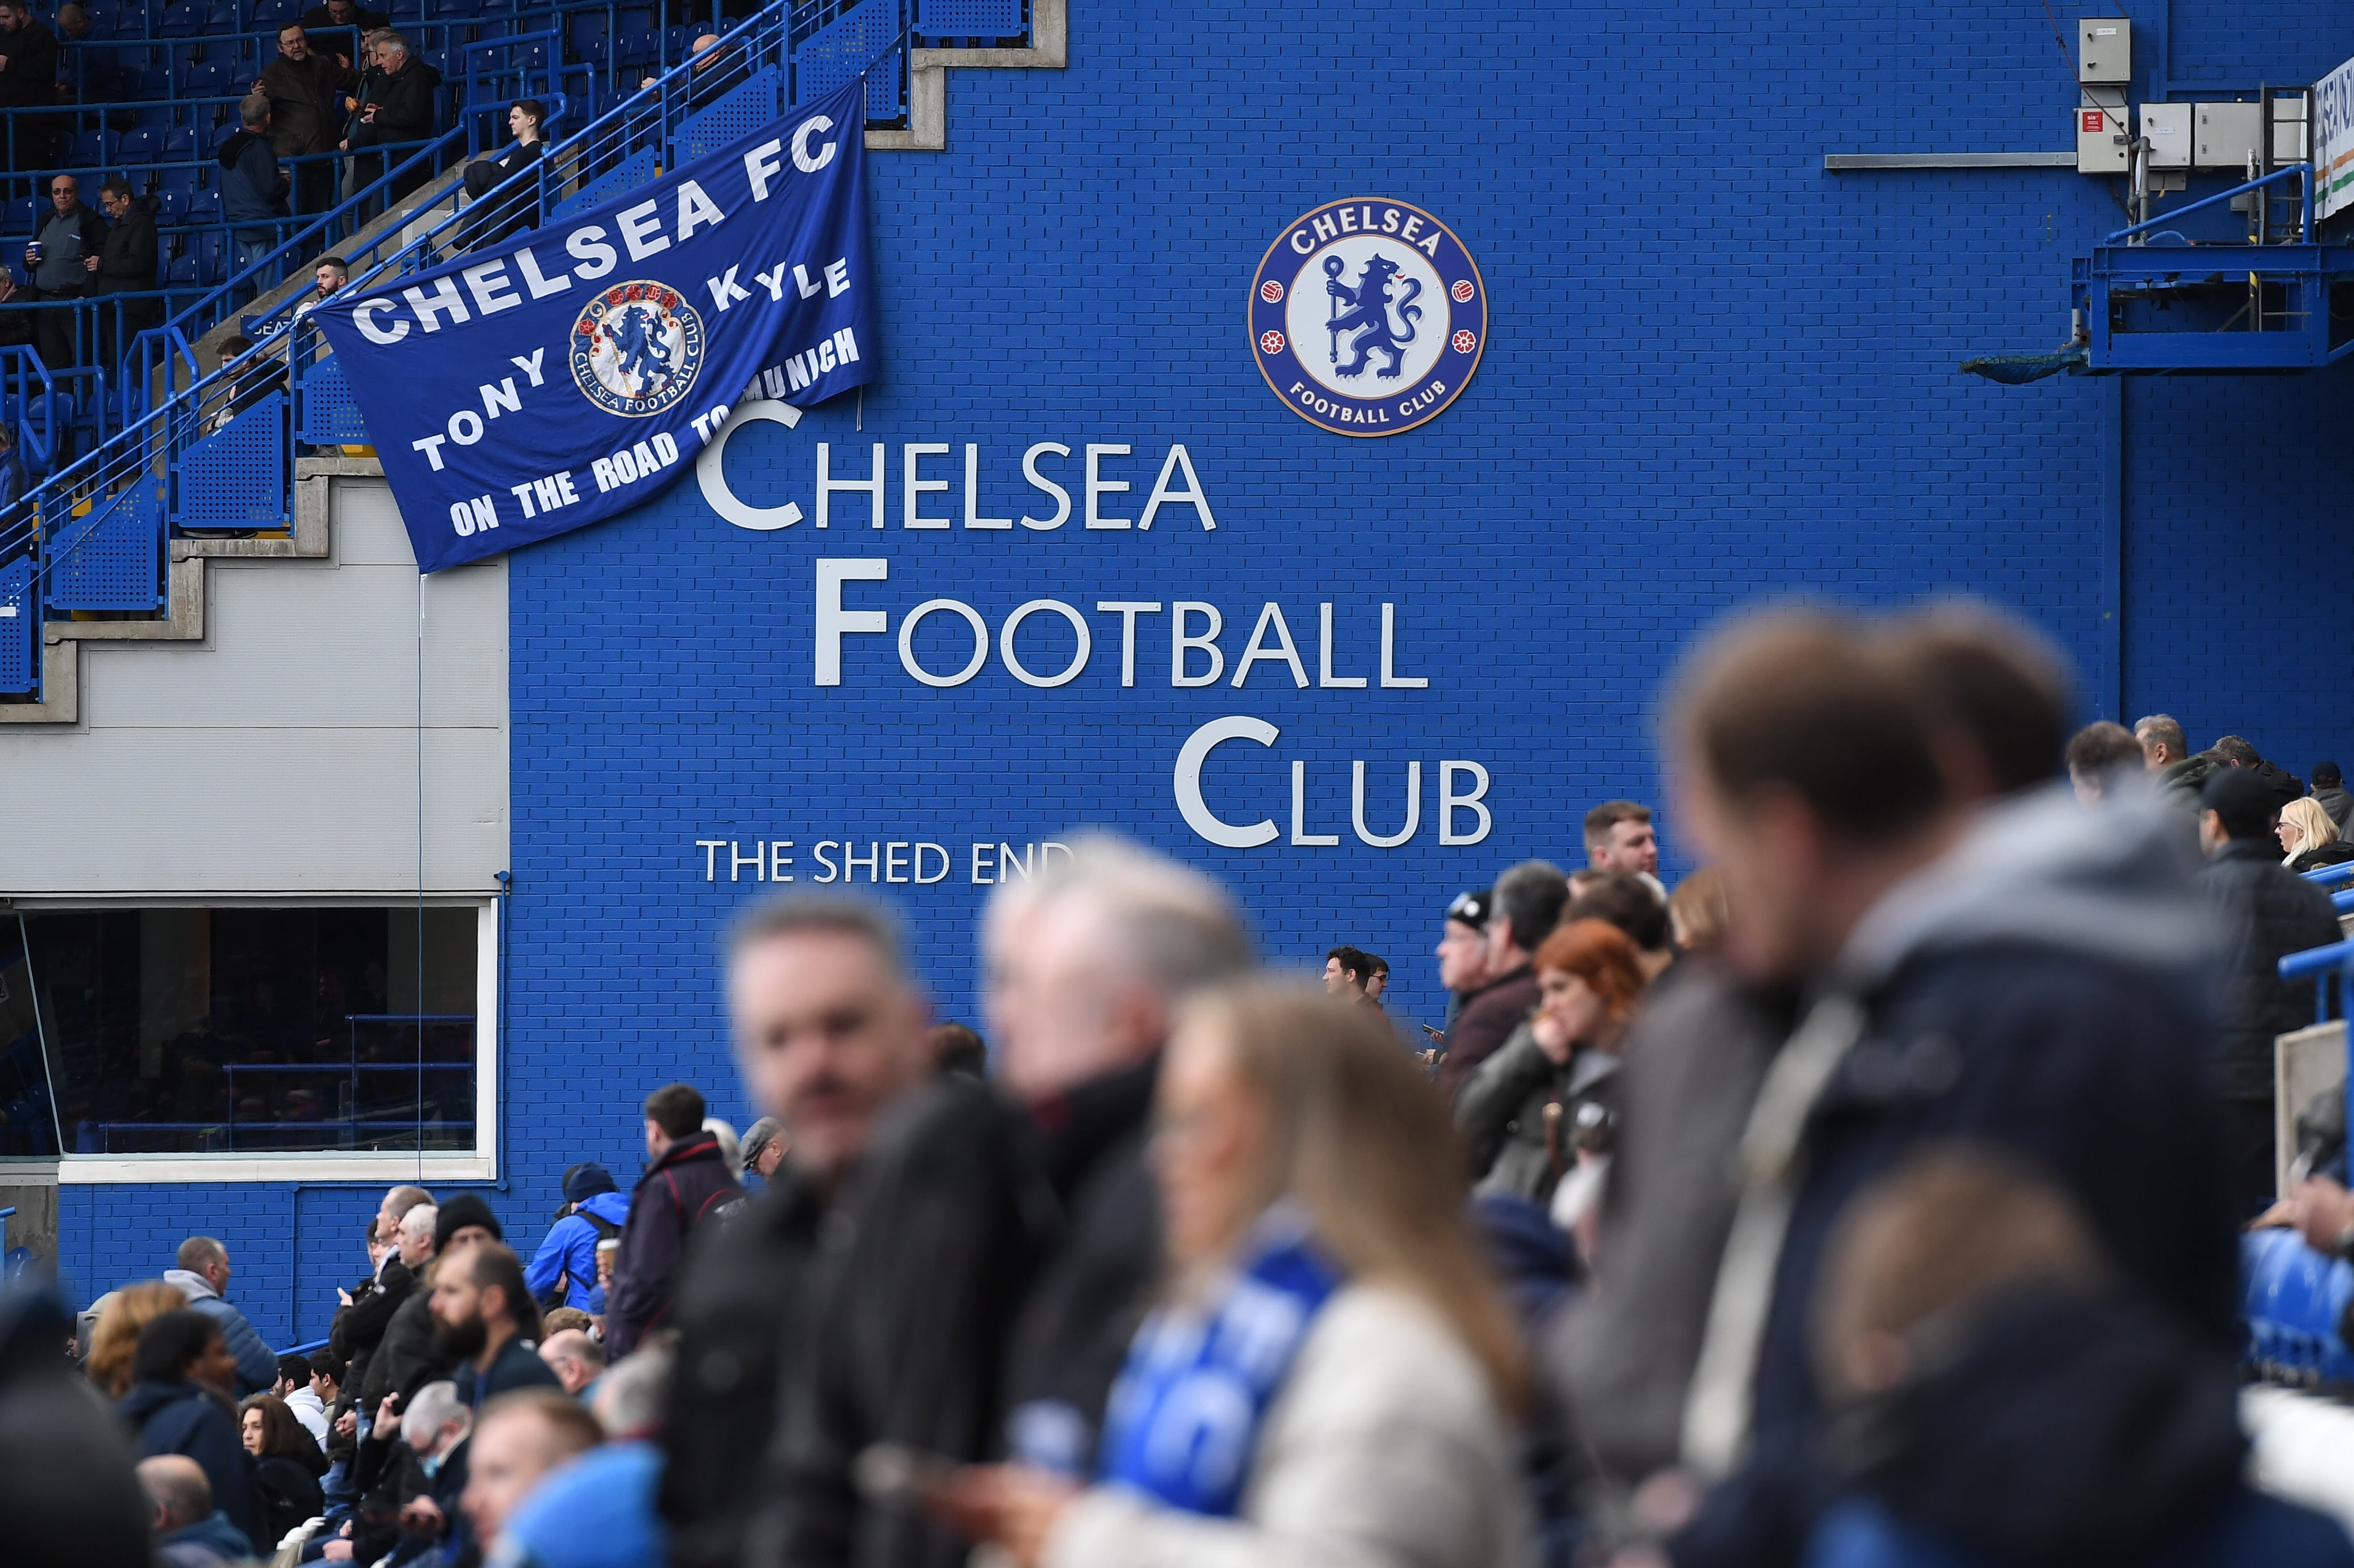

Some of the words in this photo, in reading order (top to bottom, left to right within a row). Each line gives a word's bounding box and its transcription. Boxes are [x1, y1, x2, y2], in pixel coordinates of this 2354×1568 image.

[353, 180, 725, 344] CHELSEA
[744, 115, 837, 202] FC
[1290, 206, 1442, 258] CHELSEA
[412, 347, 545, 471] TONY
[707, 256, 851, 312] KYLE
[575, 353, 618, 408] CHELSEA
[625, 362, 696, 411] FOOTBALL
[682, 312, 699, 357] CLUB
[1289, 381, 1390, 424] FOOTBALL
[1399, 380, 1447, 416] CLUB
[449, 494, 501, 537] ON
[511, 470, 580, 519] THE
[592, 432, 679, 493] ROAD
[691, 405, 731, 447] TO
[739, 326, 860, 402] MUNICH
[697, 400, 1216, 531] CHELSEA
[815, 559, 1428, 688] FOOTBALL
[1174, 716, 1491, 848] CLUB
[696, 841, 793, 883] THE
[813, 840, 949, 884] SHED
